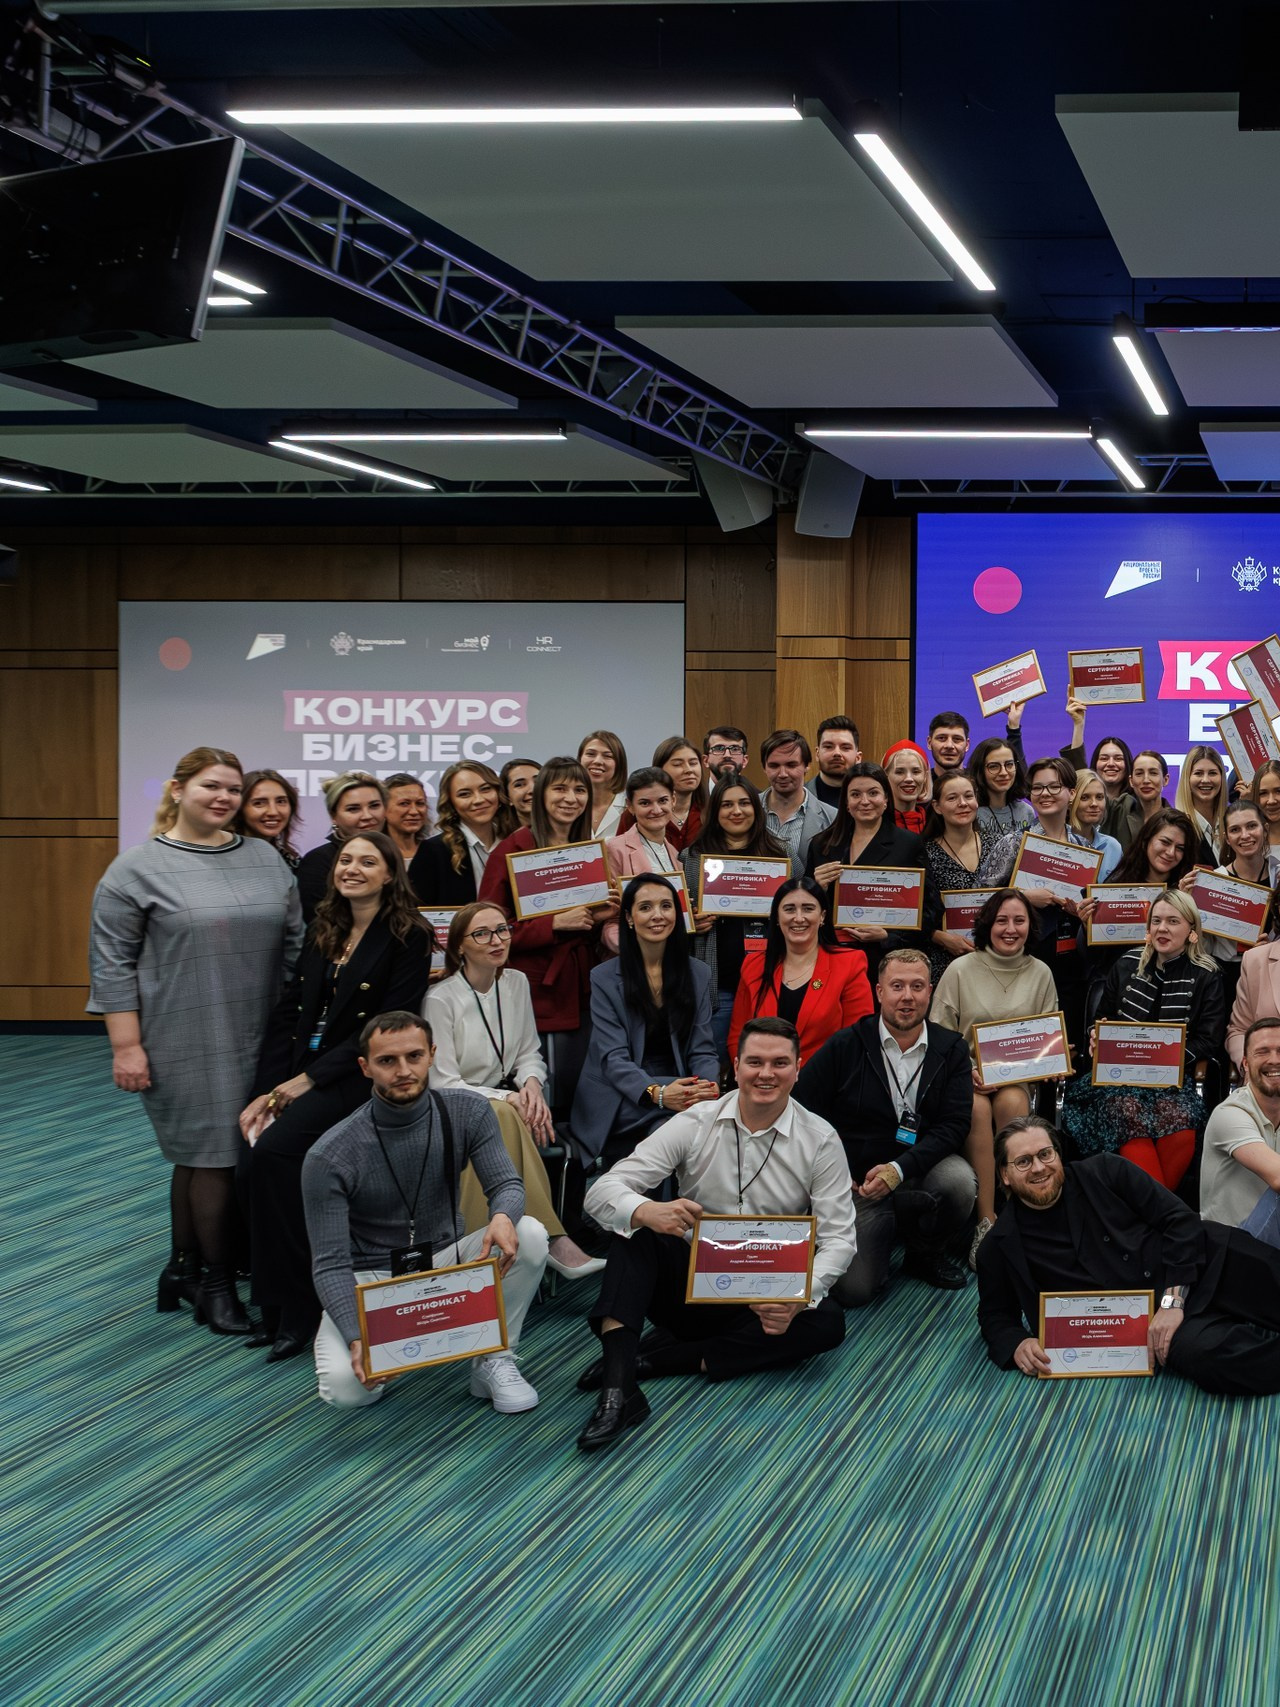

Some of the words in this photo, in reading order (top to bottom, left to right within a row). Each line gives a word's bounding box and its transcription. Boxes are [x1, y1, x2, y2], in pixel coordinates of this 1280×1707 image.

[293, 697, 522, 729] КОНКУРС
[302, 733, 513, 763] БИЗНЕС-
[534, 863, 584, 877] СЕРТИФИКАТ
[1039, 856, 1081, 871] СЕРТИФИКАТ
[722, 875, 767, 883] СЕРТИФИКАТ
[857, 885, 902, 893] СЕРТИФИКАТ
[1208, 891, 1249, 907] СЕРТИФИКАТ
[1108, 902, 1148, 910] СЕРТИФИКАТ
[998, 1035, 1044, 1048] СЕРТИФИКАТ
[1116, 1042, 1162, 1050] СЕРТИФИКАТ
[722, 1243, 784, 1251] ТИФИКАТ
[396, 1294, 467, 1316] СЕРТИФИКАТ
[1069, 1318, 1126, 1326] СЕРТИФИКАТ
